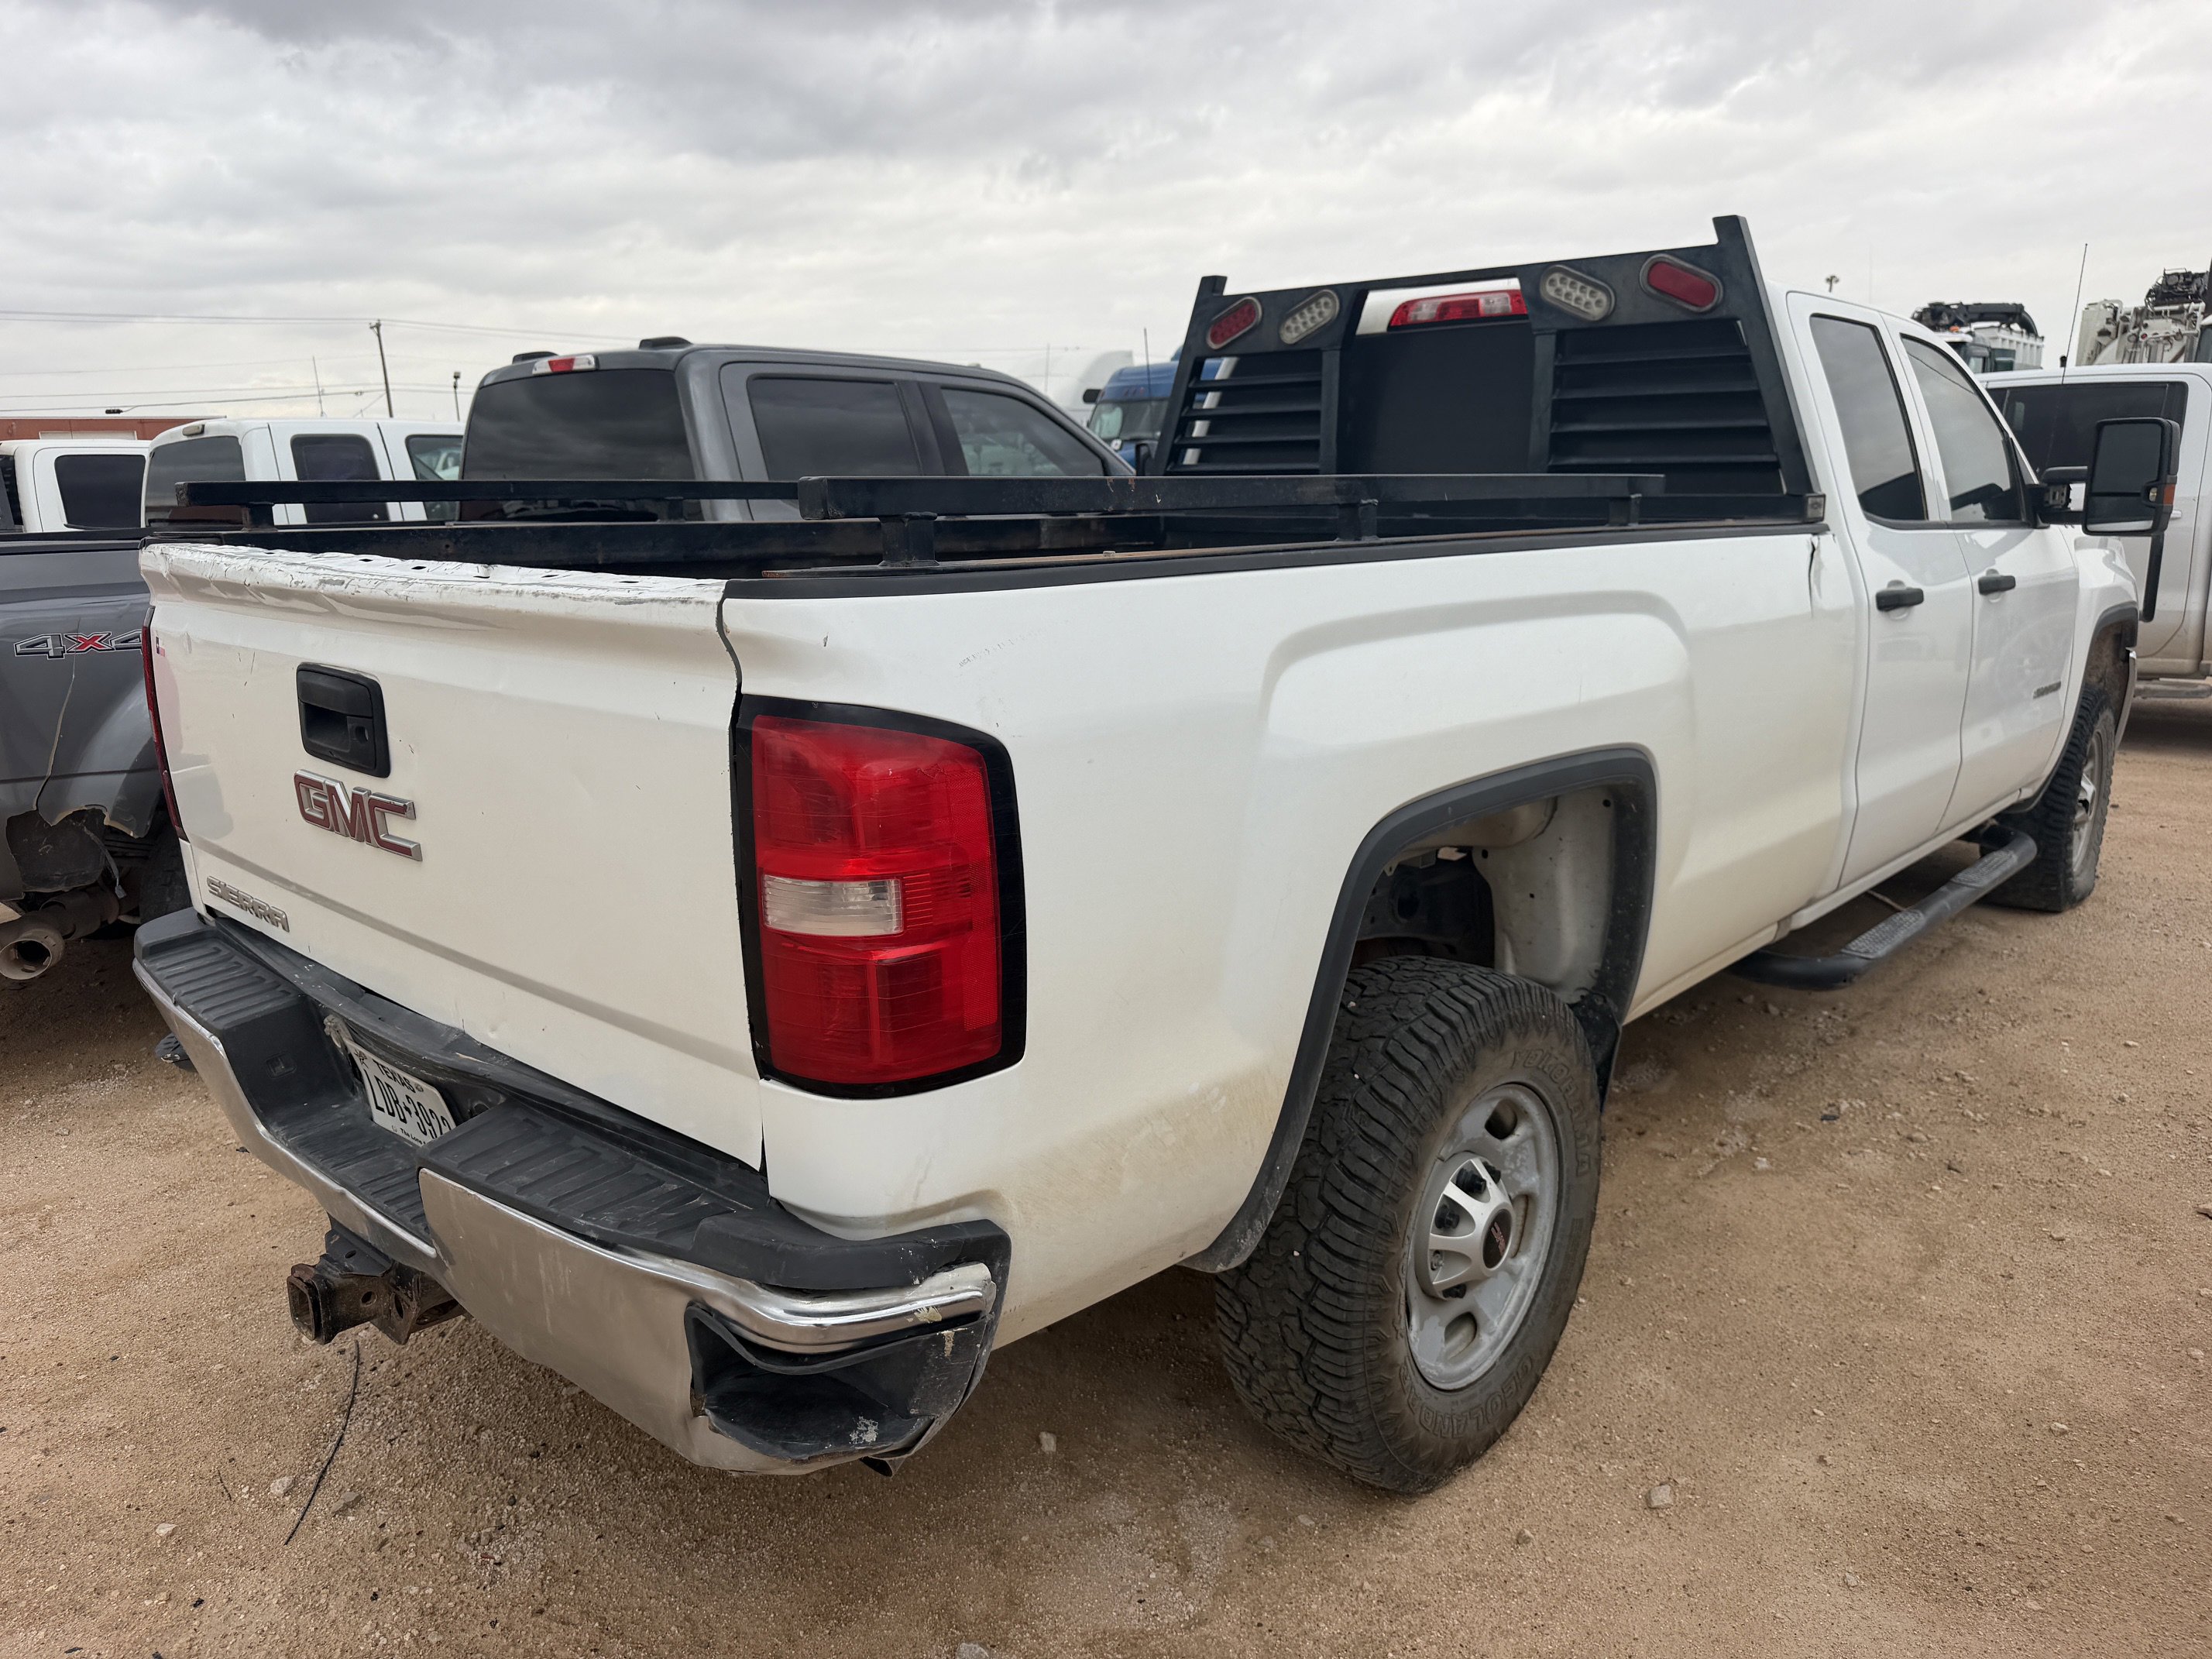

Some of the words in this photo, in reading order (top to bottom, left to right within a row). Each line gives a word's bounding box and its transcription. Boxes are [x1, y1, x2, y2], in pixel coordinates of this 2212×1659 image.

[294, 769, 423, 861] GMC
[206, 875, 290, 933] SIERRA
[373, 1059, 417, 1094] TEXAS
[1510, 1048, 1591, 1177] YOKOHAMA
